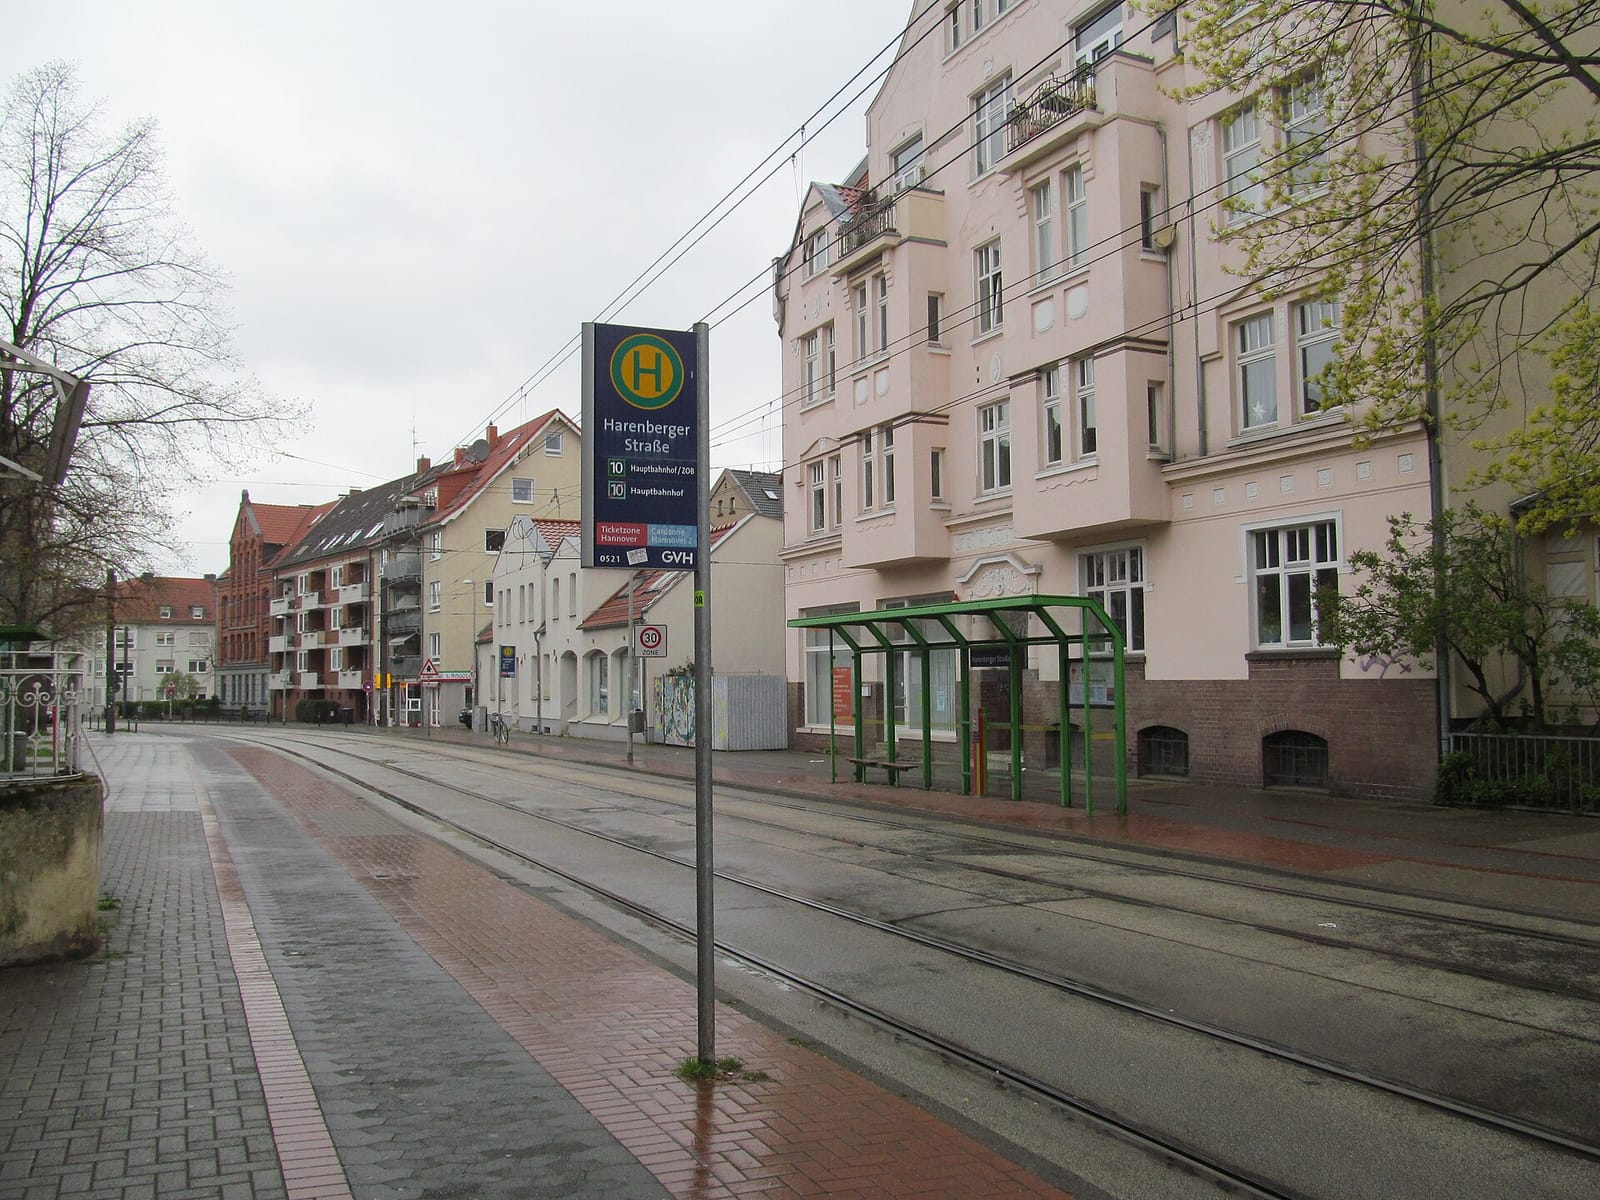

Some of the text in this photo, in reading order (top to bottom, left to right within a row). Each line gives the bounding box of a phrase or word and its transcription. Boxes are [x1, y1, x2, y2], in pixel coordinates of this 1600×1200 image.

[633, 351, 662, 392] H
[604, 418, 690, 439] Harenberger
[624, 438, 670, 453] Straße
[610, 461, 623, 474] 10
[610, 484, 684, 497] 10 Hauptbahnhof
[601, 525, 641, 535] Ticketzone
[651, 527, 686, 536] Cardzone
[601, 534, 638, 543] Hannover
[600, 555, 620, 563] 0521
[661, 550, 694, 565] GVH
[644, 632, 657, 644] 30
